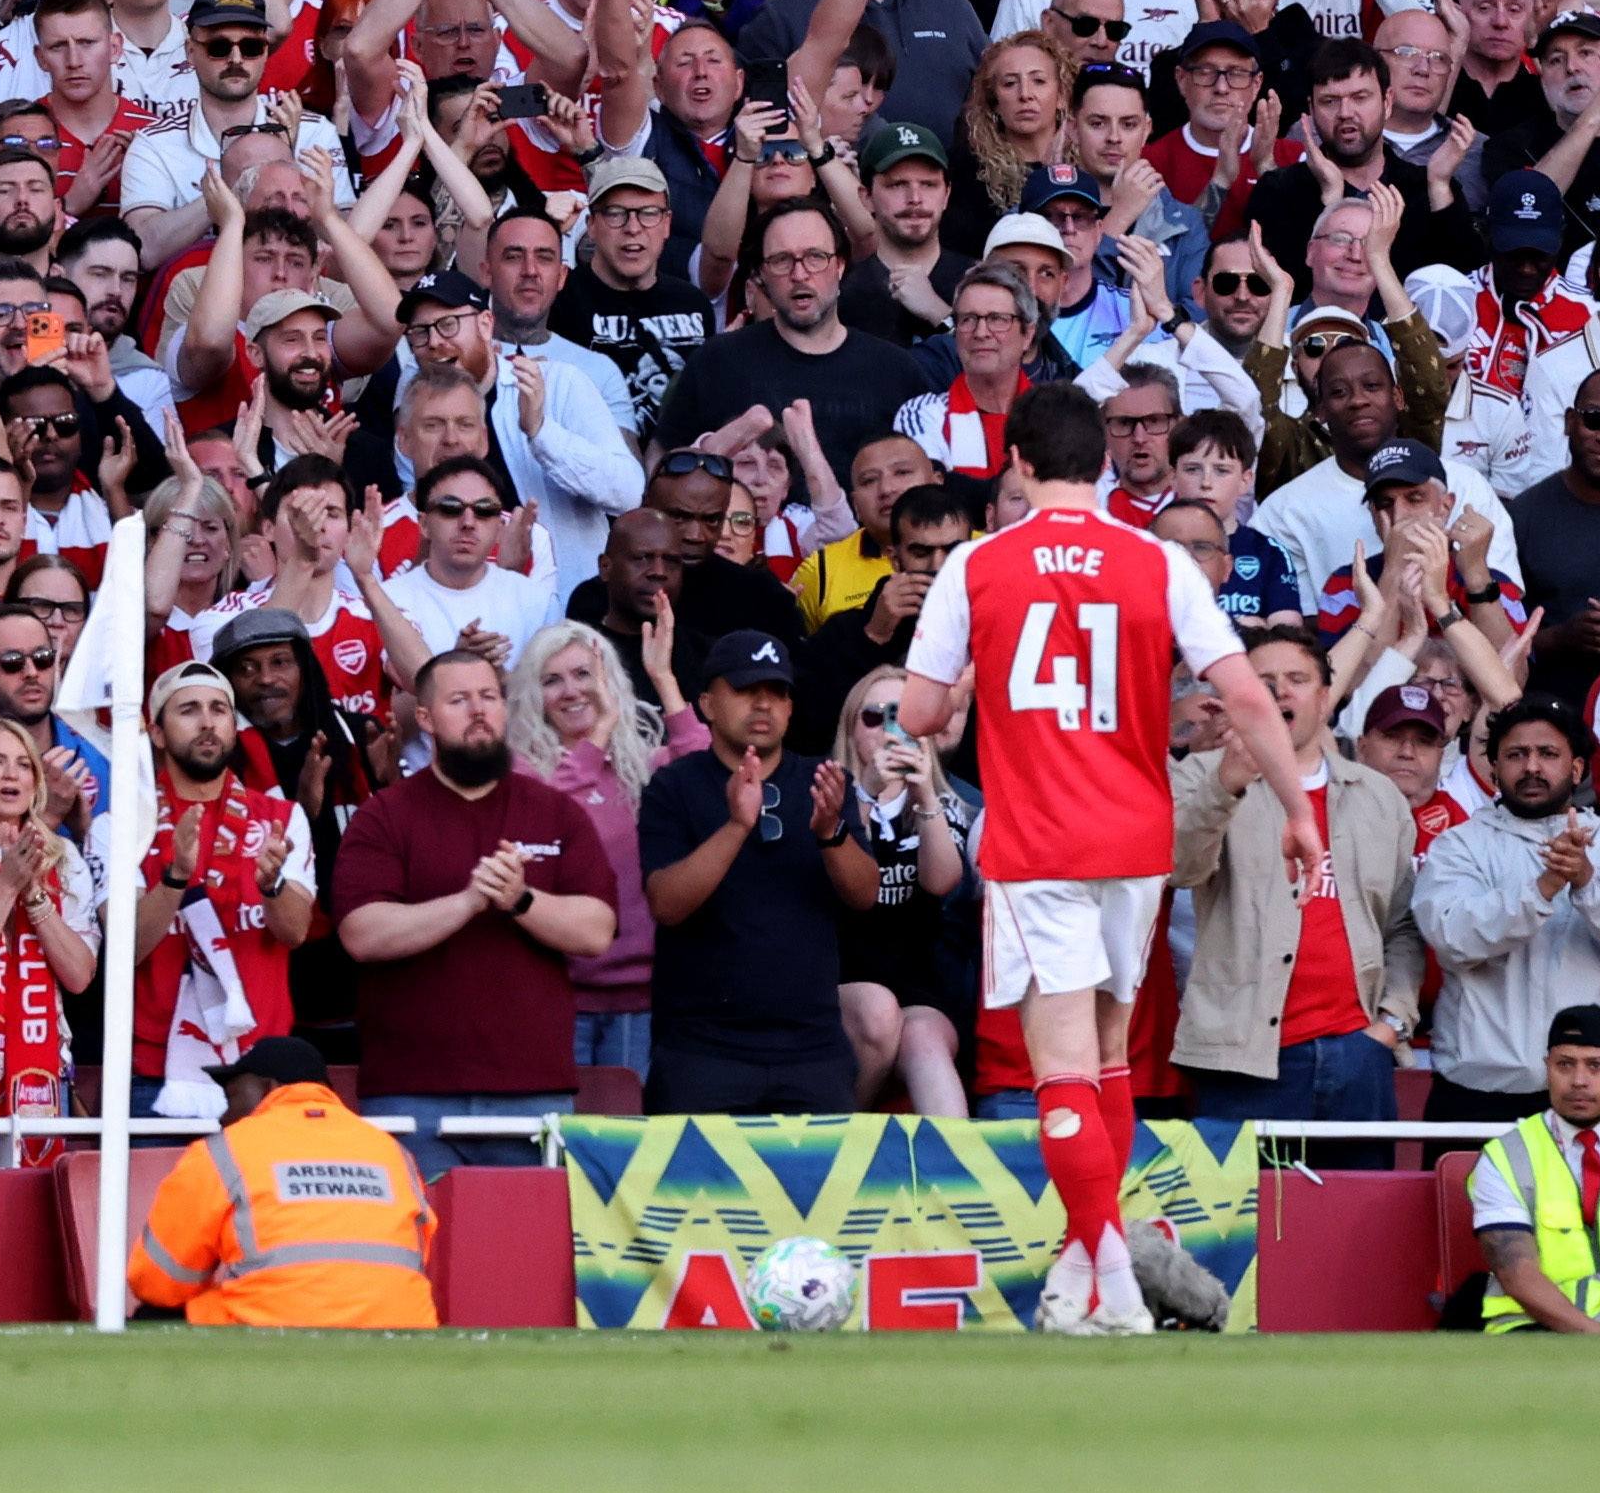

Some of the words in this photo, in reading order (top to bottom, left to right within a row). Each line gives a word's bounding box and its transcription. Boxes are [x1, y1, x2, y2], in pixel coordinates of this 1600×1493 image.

[897, 126, 921, 146] LA
[1369, 447, 1411, 470] ARSENAL
[1033, 544, 1105, 577] RICE
[1220, 592, 1262, 614] ates
[1008, 602, 1118, 732] 41
[19, 934, 48, 1045] CLUB
[285, 1164, 378, 1181] ARSENAL
[288, 1183, 383, 1199] STEWARD
